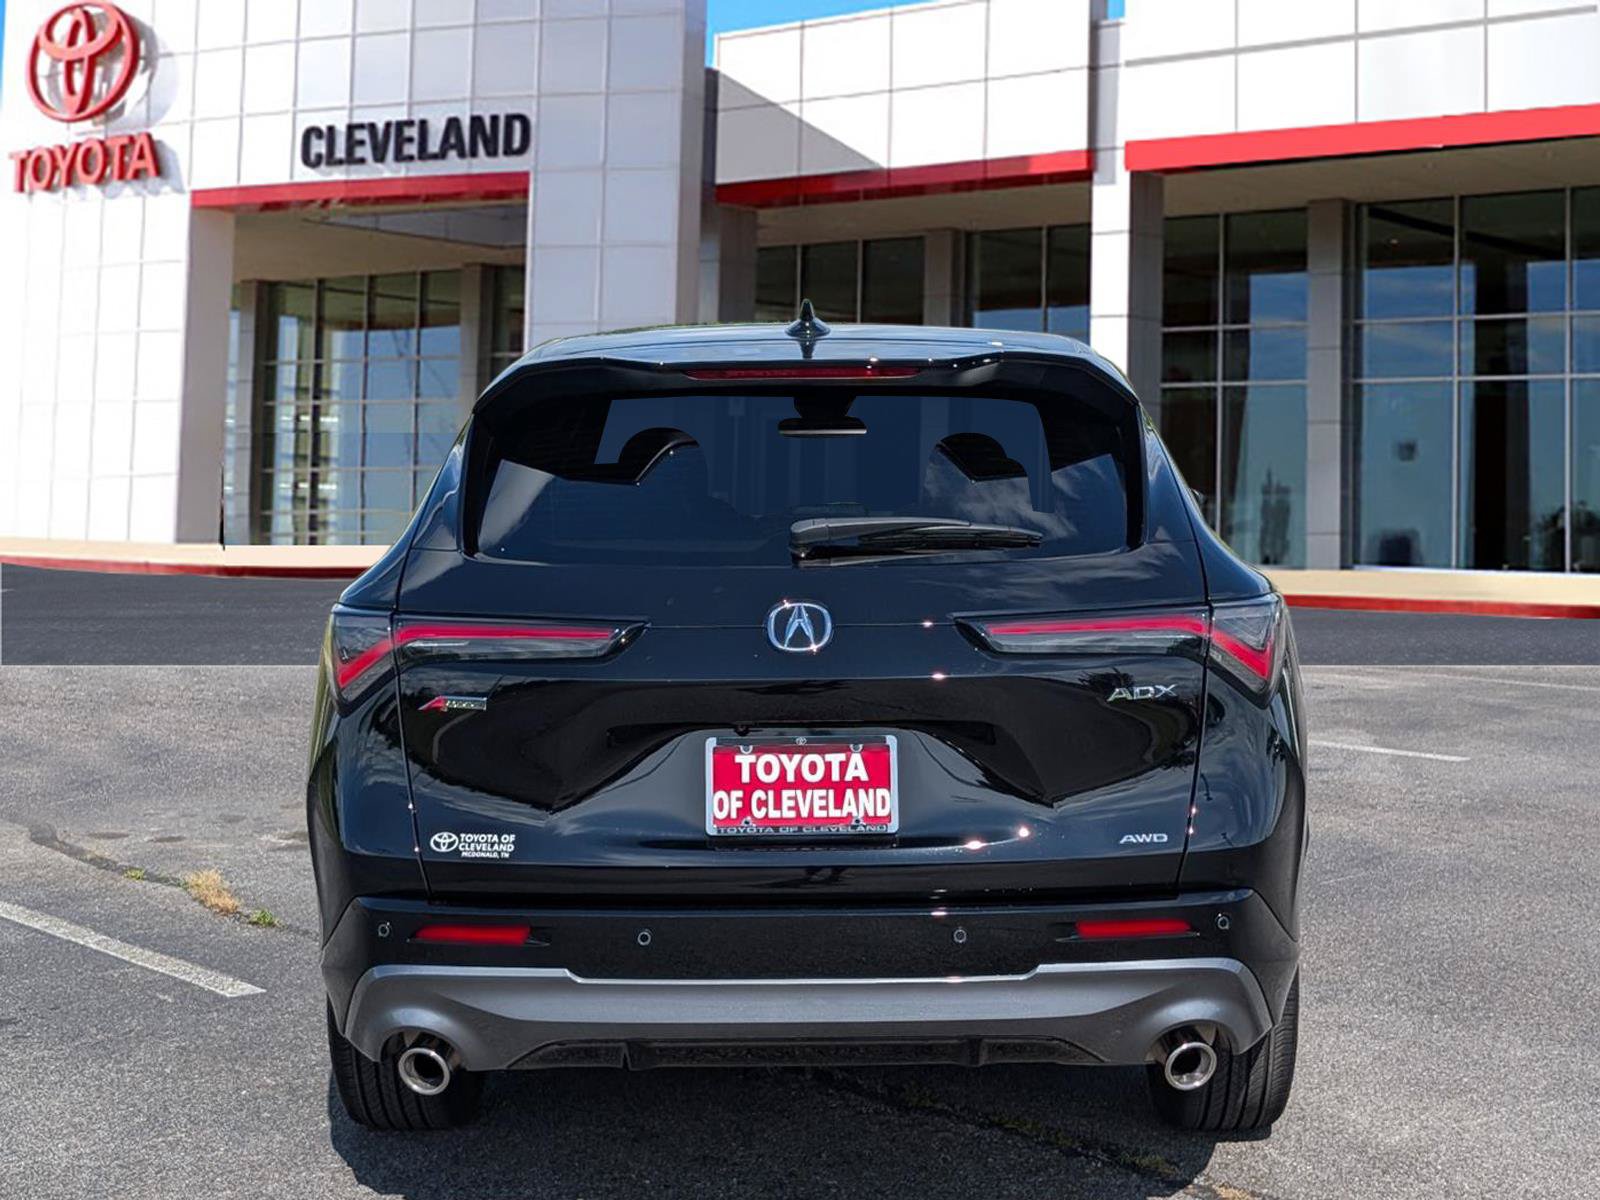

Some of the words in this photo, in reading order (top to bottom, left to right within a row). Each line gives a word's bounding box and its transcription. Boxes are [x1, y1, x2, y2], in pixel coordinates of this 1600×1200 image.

[301, 113, 531, 168] CLEVELAND
[9, 131, 160, 193] TOYOTA
[1107, 684, 1178, 702] ADX
[735, 753, 869, 784] TOYOTA
[713, 790, 743, 819] OF
[751, 788, 891, 819] CLEVELAND
[719, 825, 774, 834] TOYOTA
[779, 825, 798, 834] OF
[803, 824, 887, 834] CLEVELAND
[459, 833, 499, 843] TOYOTA
[501, 834, 516, 844] OF
[459, 843, 515, 852] CLEVELAND
[1119, 833, 1168, 844] AWD
